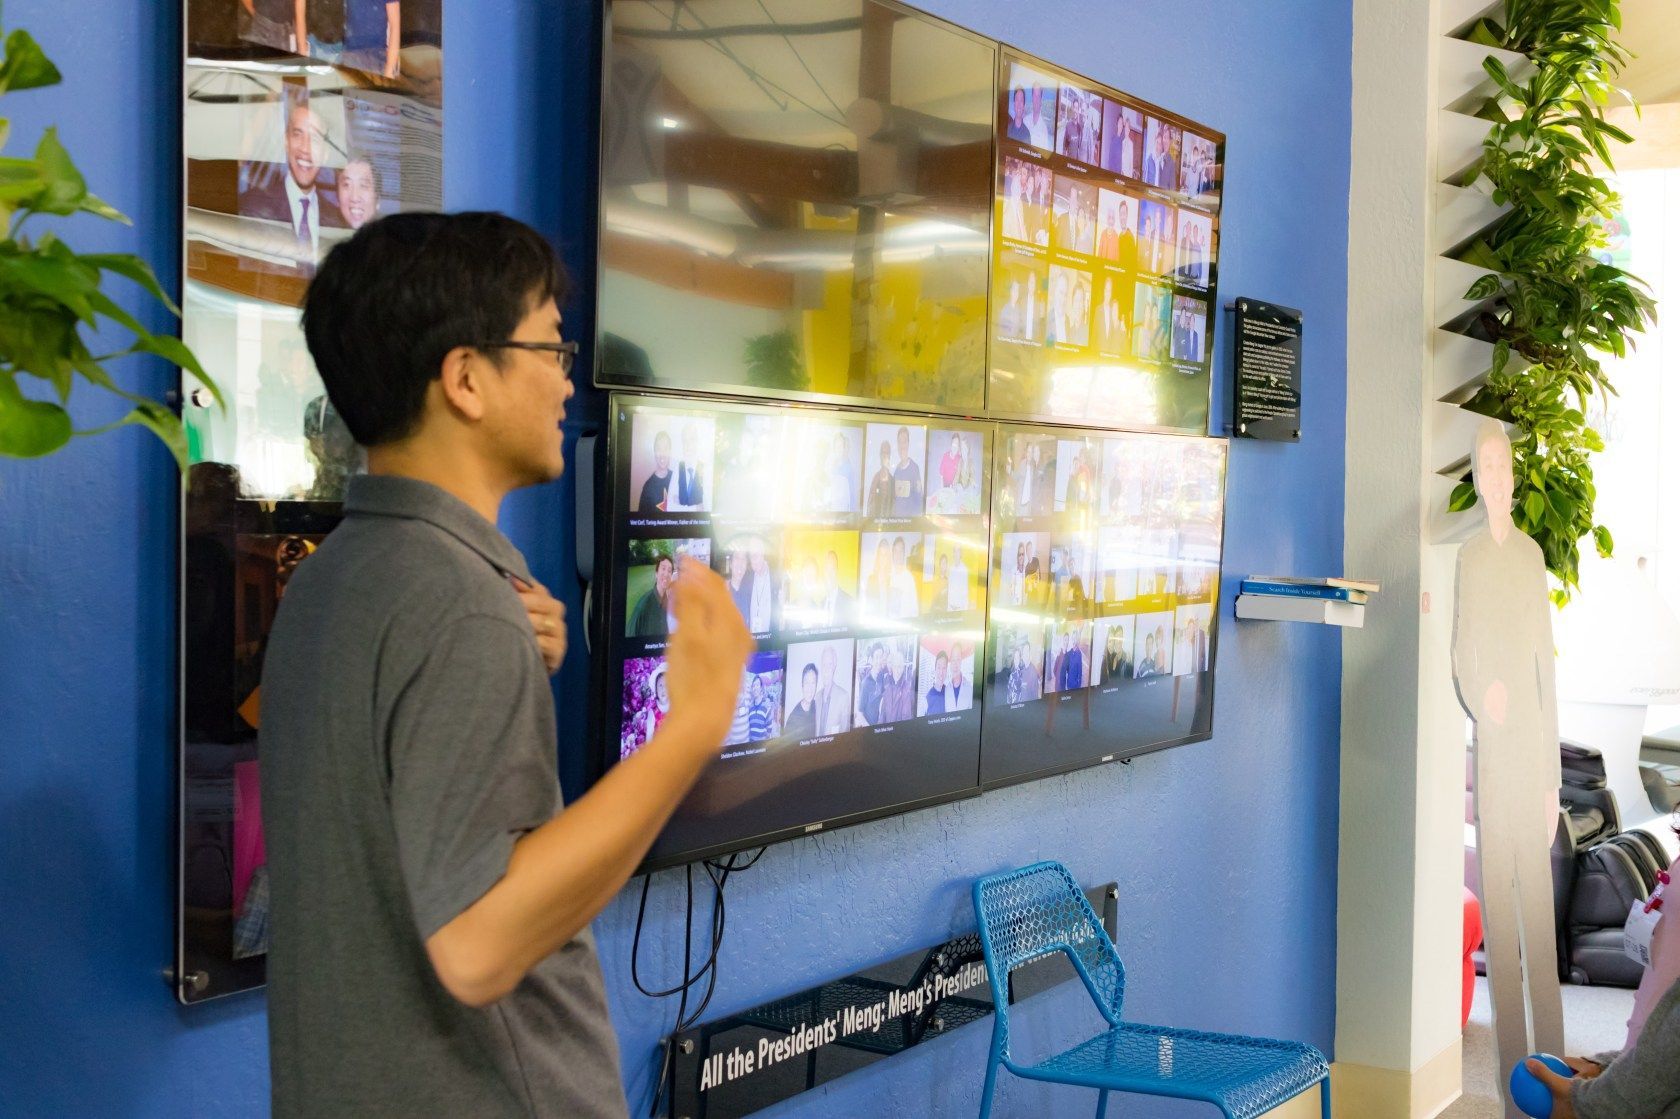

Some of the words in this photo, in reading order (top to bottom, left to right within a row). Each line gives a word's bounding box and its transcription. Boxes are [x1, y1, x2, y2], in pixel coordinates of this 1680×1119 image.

[1301, 588, 1321, 596] Yourself
[700, 1052, 723, 1092] All
[726, 1046, 754, 1081] the
[758, 1010, 841, 1069] Presidents'
[843, 1001, 886, 1037] Meng:
[887, 978, 933, 1020] Meng's
